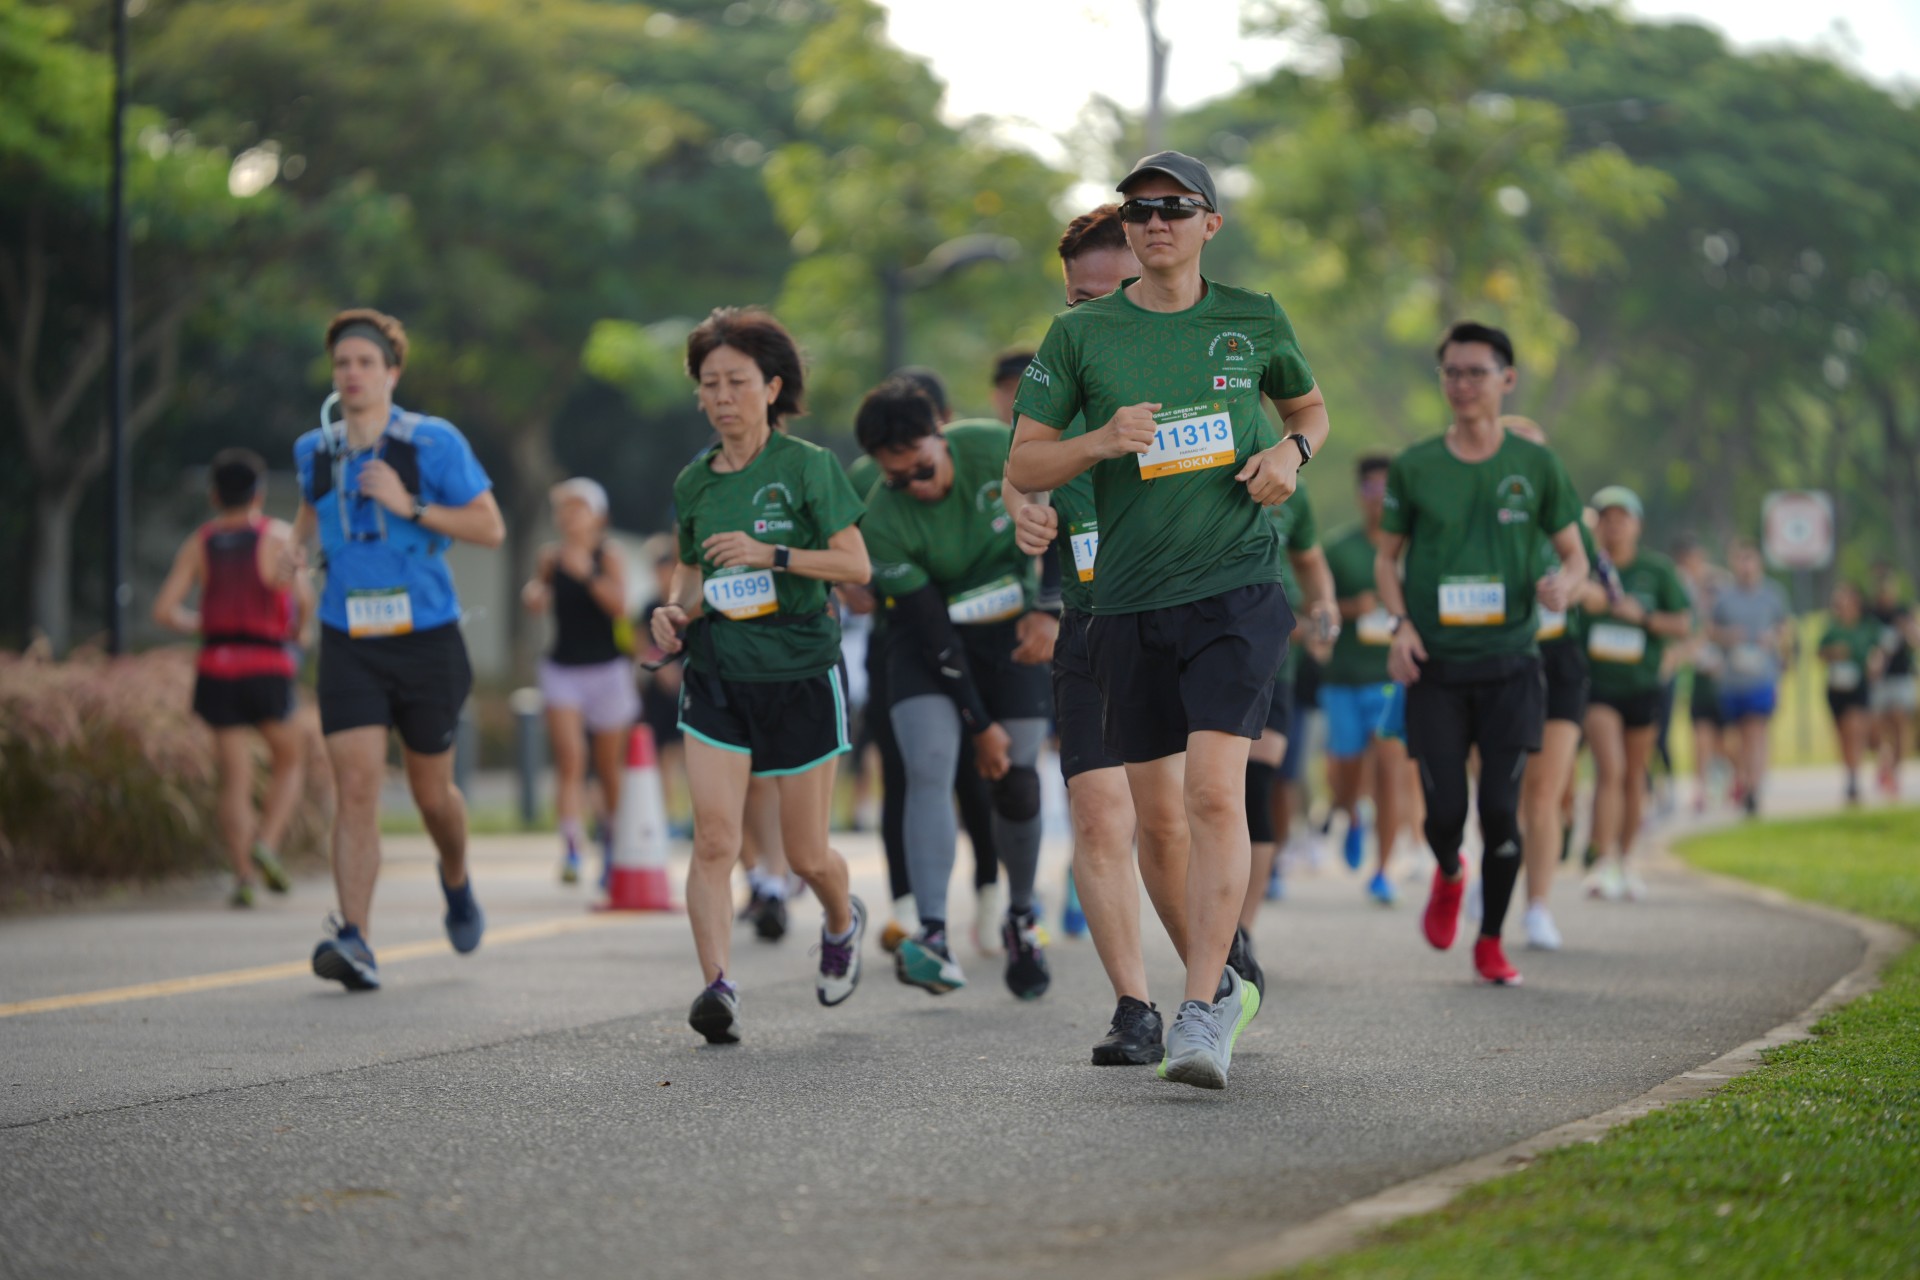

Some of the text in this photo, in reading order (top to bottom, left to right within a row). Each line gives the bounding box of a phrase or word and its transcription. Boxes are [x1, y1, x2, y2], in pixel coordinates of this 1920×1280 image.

[1208, 331, 1255, 357] GREAT GREEN RUN
[1228, 377, 1252, 389] CIMB
[1152, 411, 1172, 420] GREAT
[1173, 407, 1194, 416] GREEN
[1154, 419, 1229, 451] 11313
[1177, 455, 1214, 469] 10KM
[709, 576, 770, 602] 11699
